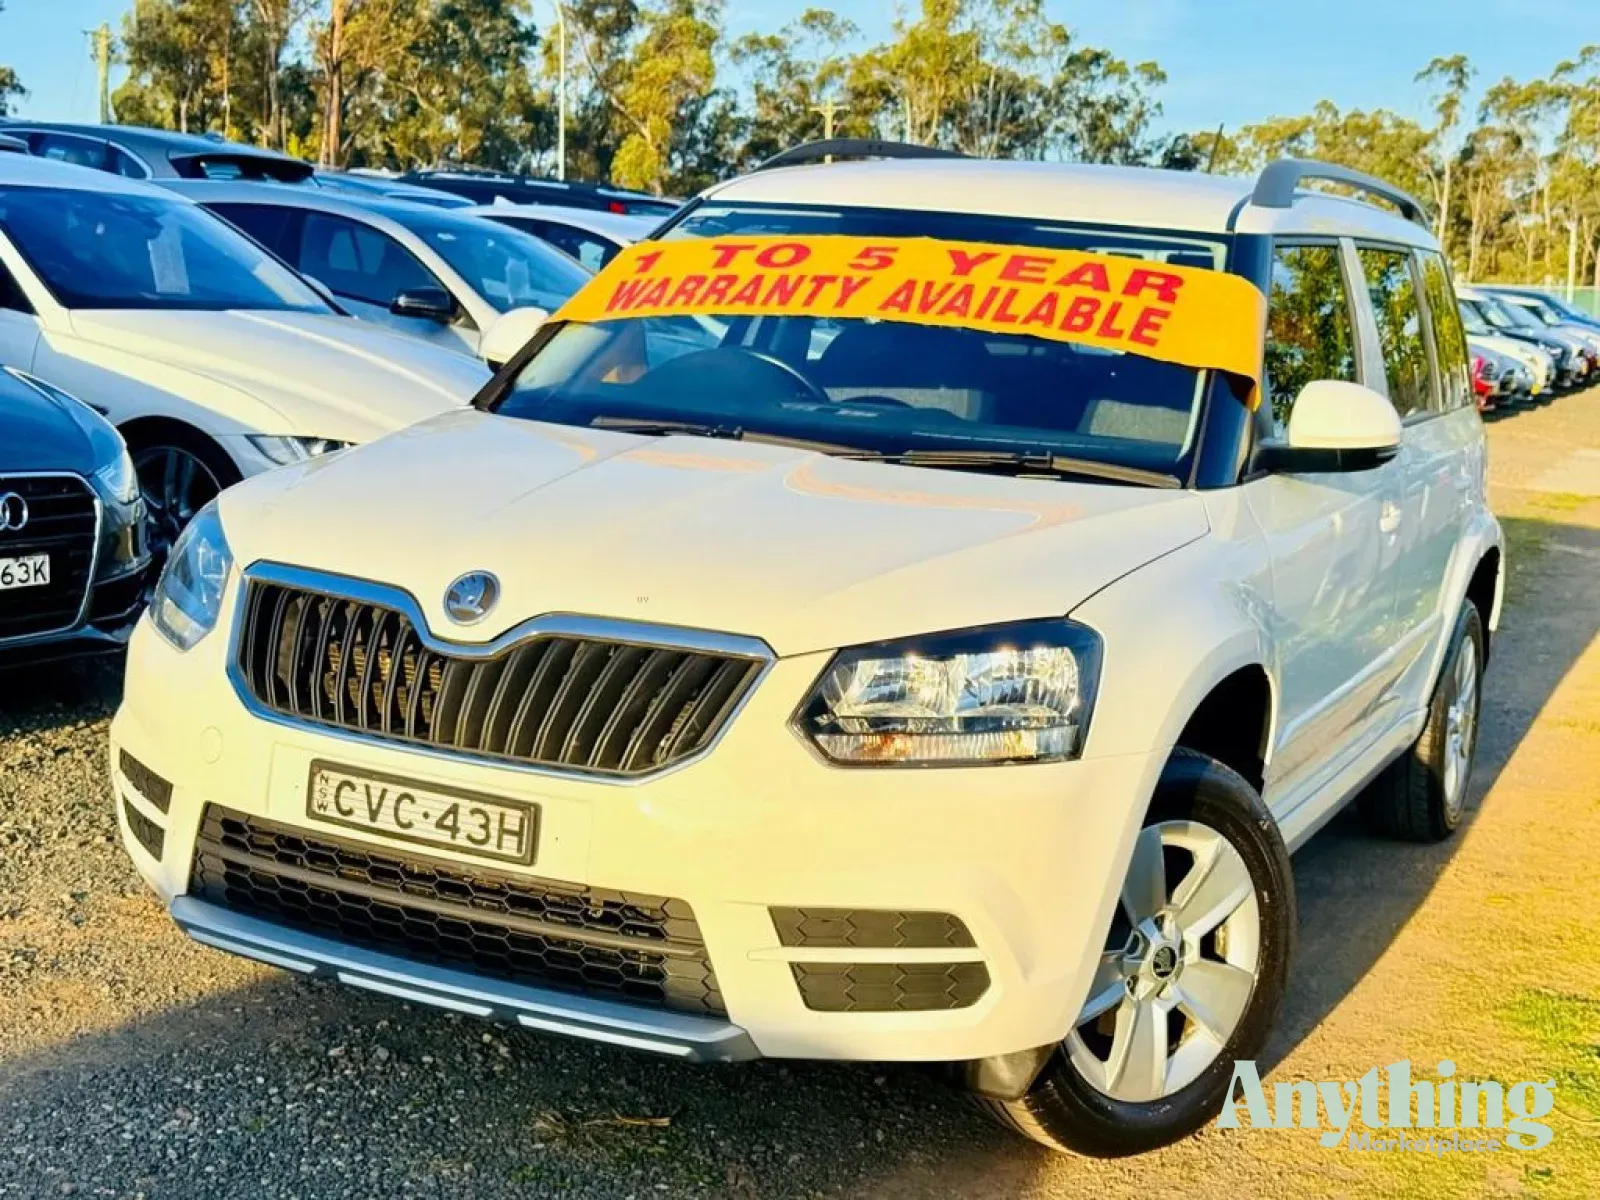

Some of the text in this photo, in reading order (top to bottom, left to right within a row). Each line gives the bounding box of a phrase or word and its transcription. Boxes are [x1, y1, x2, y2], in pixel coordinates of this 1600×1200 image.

[633, 243, 1184, 305] 1 TO 5 YEAR
[604, 274, 1172, 347] WARRANTY AVAILABLE
